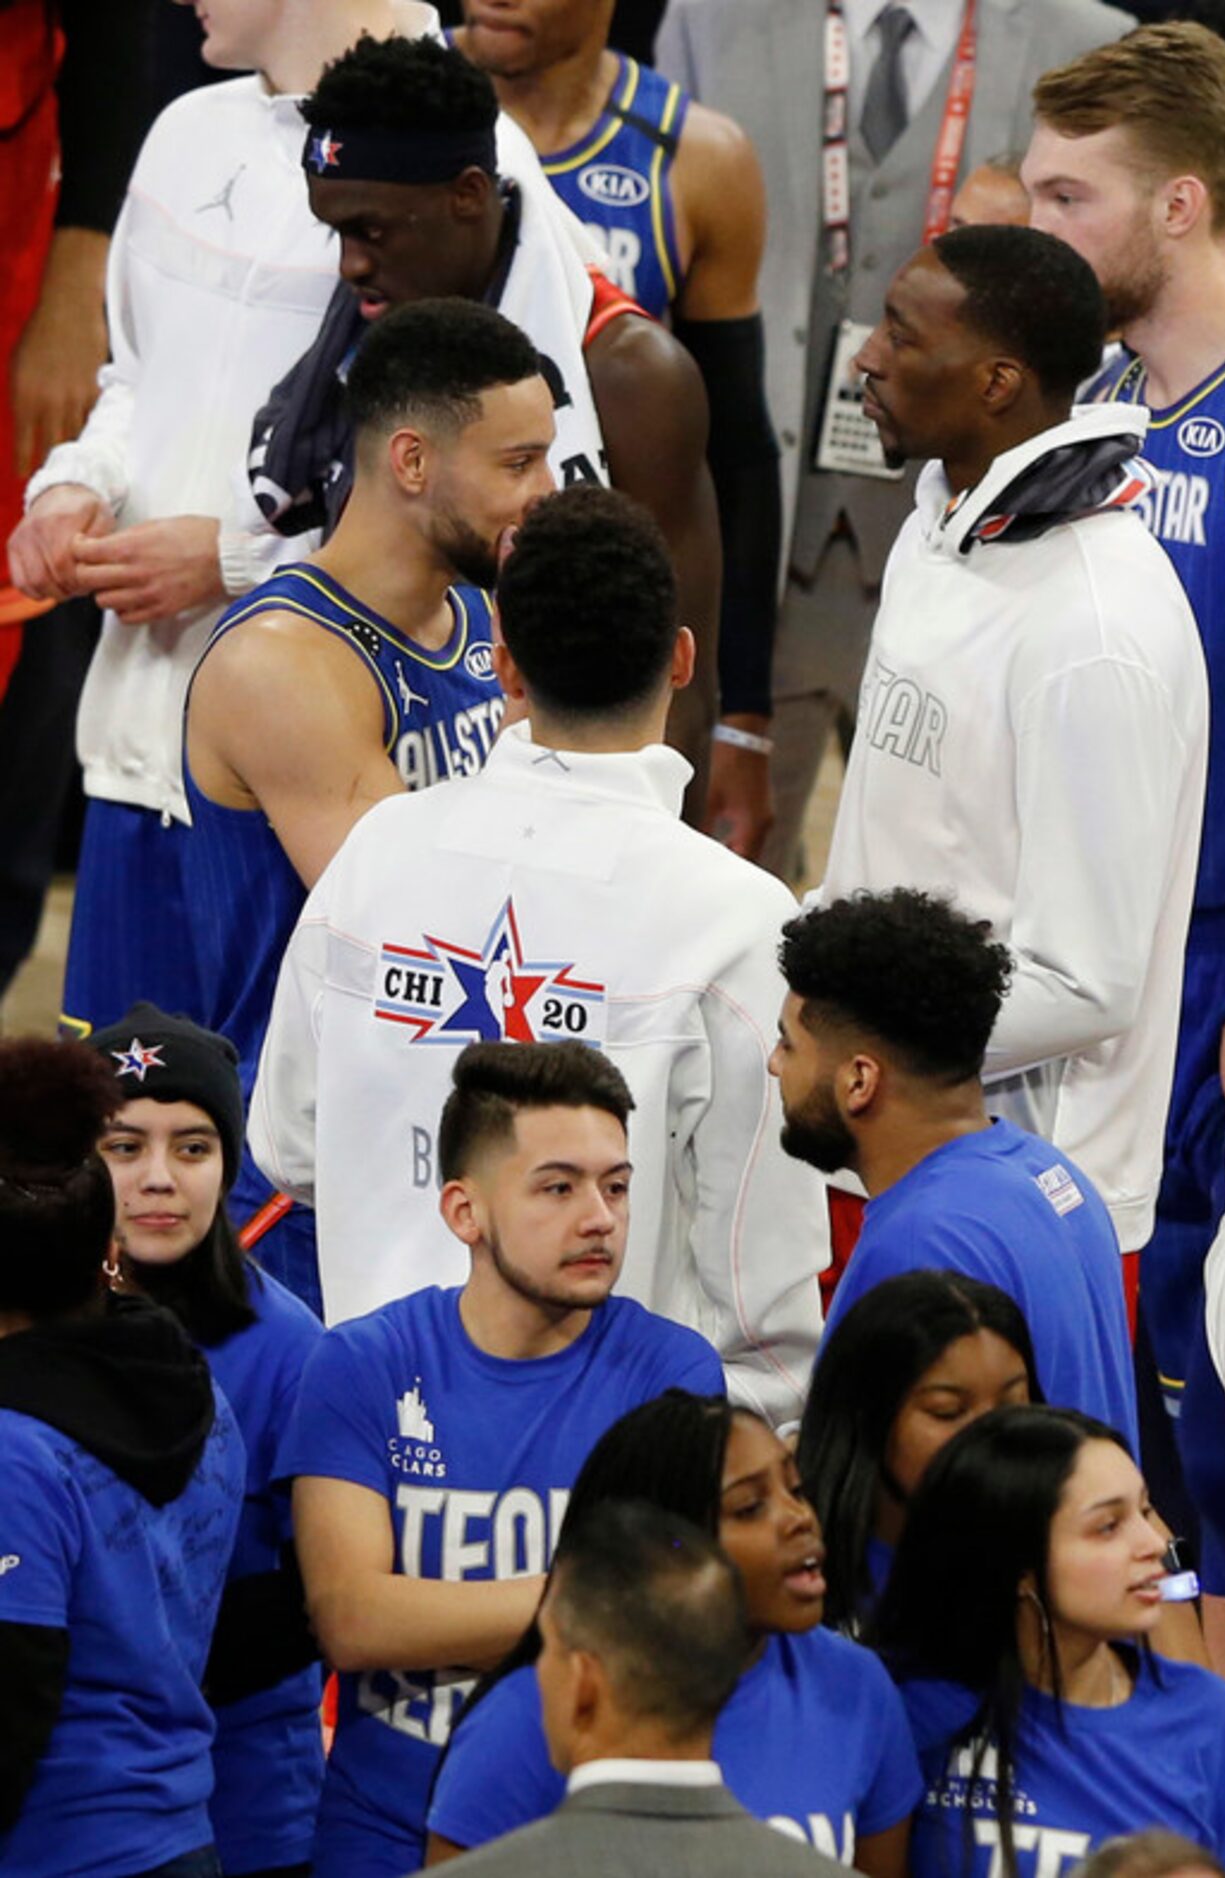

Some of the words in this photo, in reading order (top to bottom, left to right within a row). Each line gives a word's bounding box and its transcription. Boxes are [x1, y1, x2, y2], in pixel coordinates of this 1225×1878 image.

[590, 172, 638, 199] KIA
[584, 222, 642, 298] R
[1186, 423, 1217, 451] KIA
[385, 967, 444, 1006] CHI
[542, 999, 588, 1033] 20
